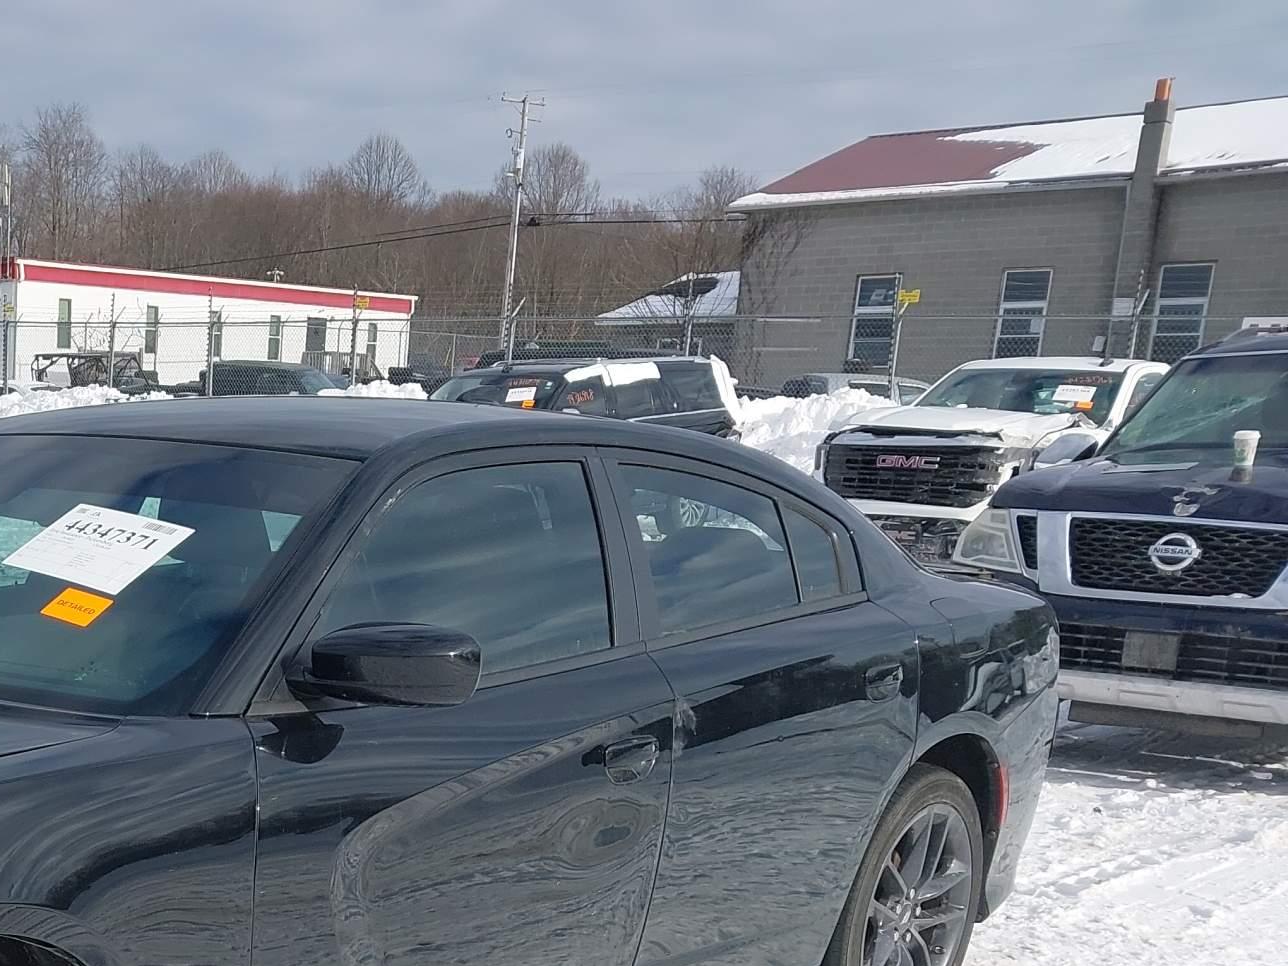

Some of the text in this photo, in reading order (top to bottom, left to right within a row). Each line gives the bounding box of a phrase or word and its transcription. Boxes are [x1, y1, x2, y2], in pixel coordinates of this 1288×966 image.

[875, 454, 941, 469] GMC
[64, 519, 160, 550] 44347371
[1152, 546, 1193, 556] NISSAN
[56, 598, 96, 616] DETAILED
